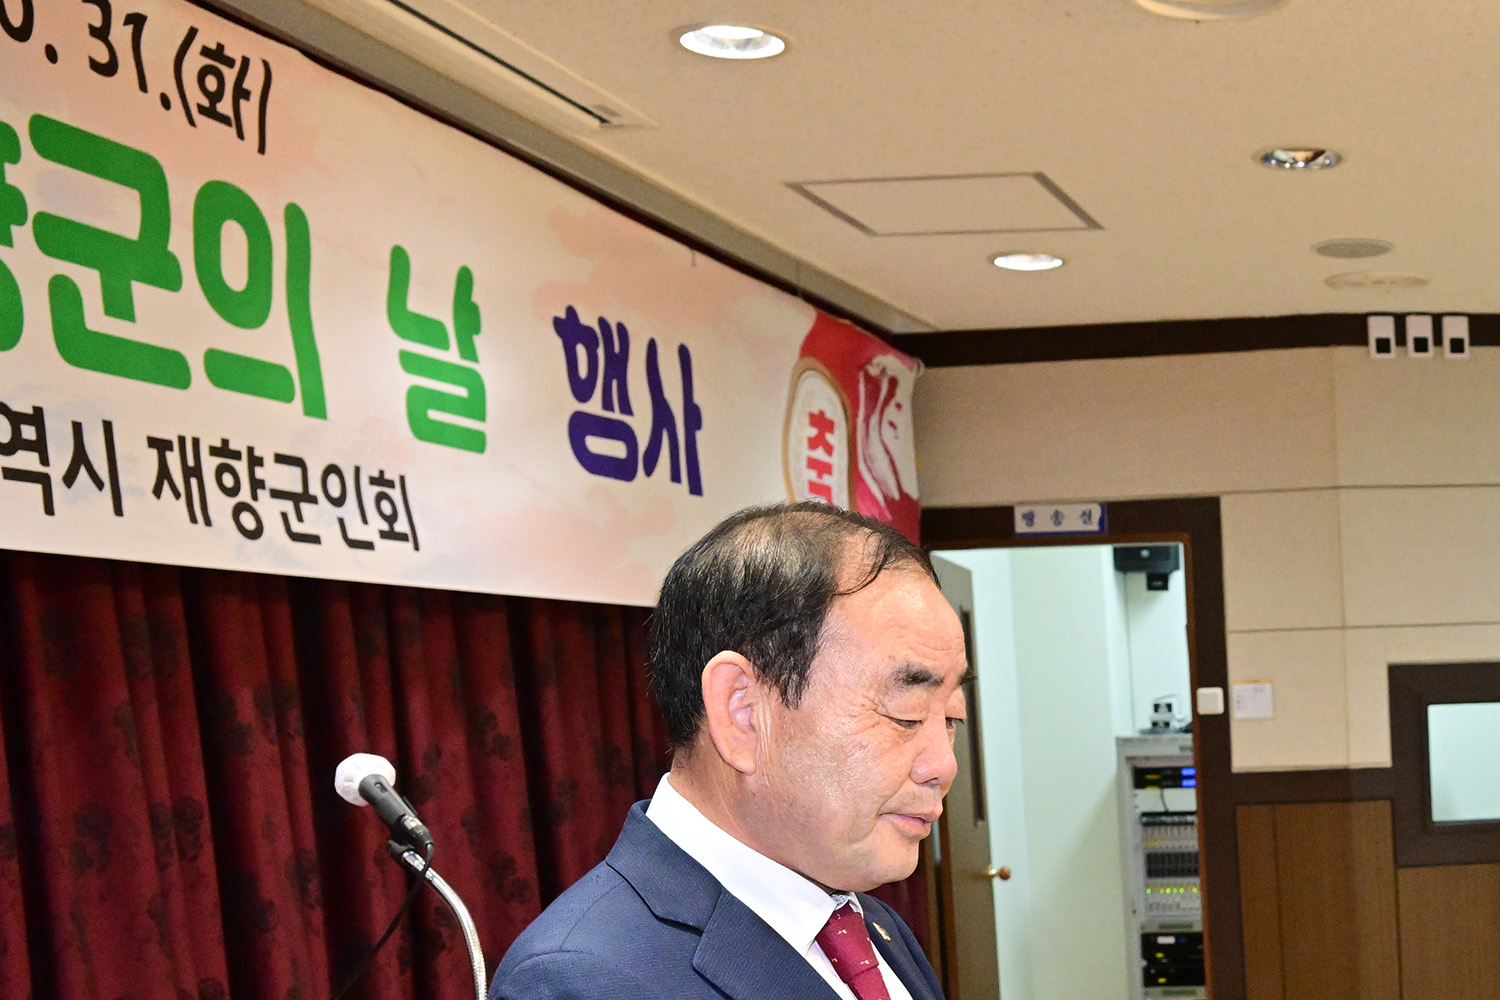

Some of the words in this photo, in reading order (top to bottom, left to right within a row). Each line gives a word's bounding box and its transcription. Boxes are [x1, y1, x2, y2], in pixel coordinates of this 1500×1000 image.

[0, 113, 328, 420] 군의
[387, 244, 487, 455] 날
[552, 304, 704, 497] 행사
[146, 434, 421, 552] 재향군인회
